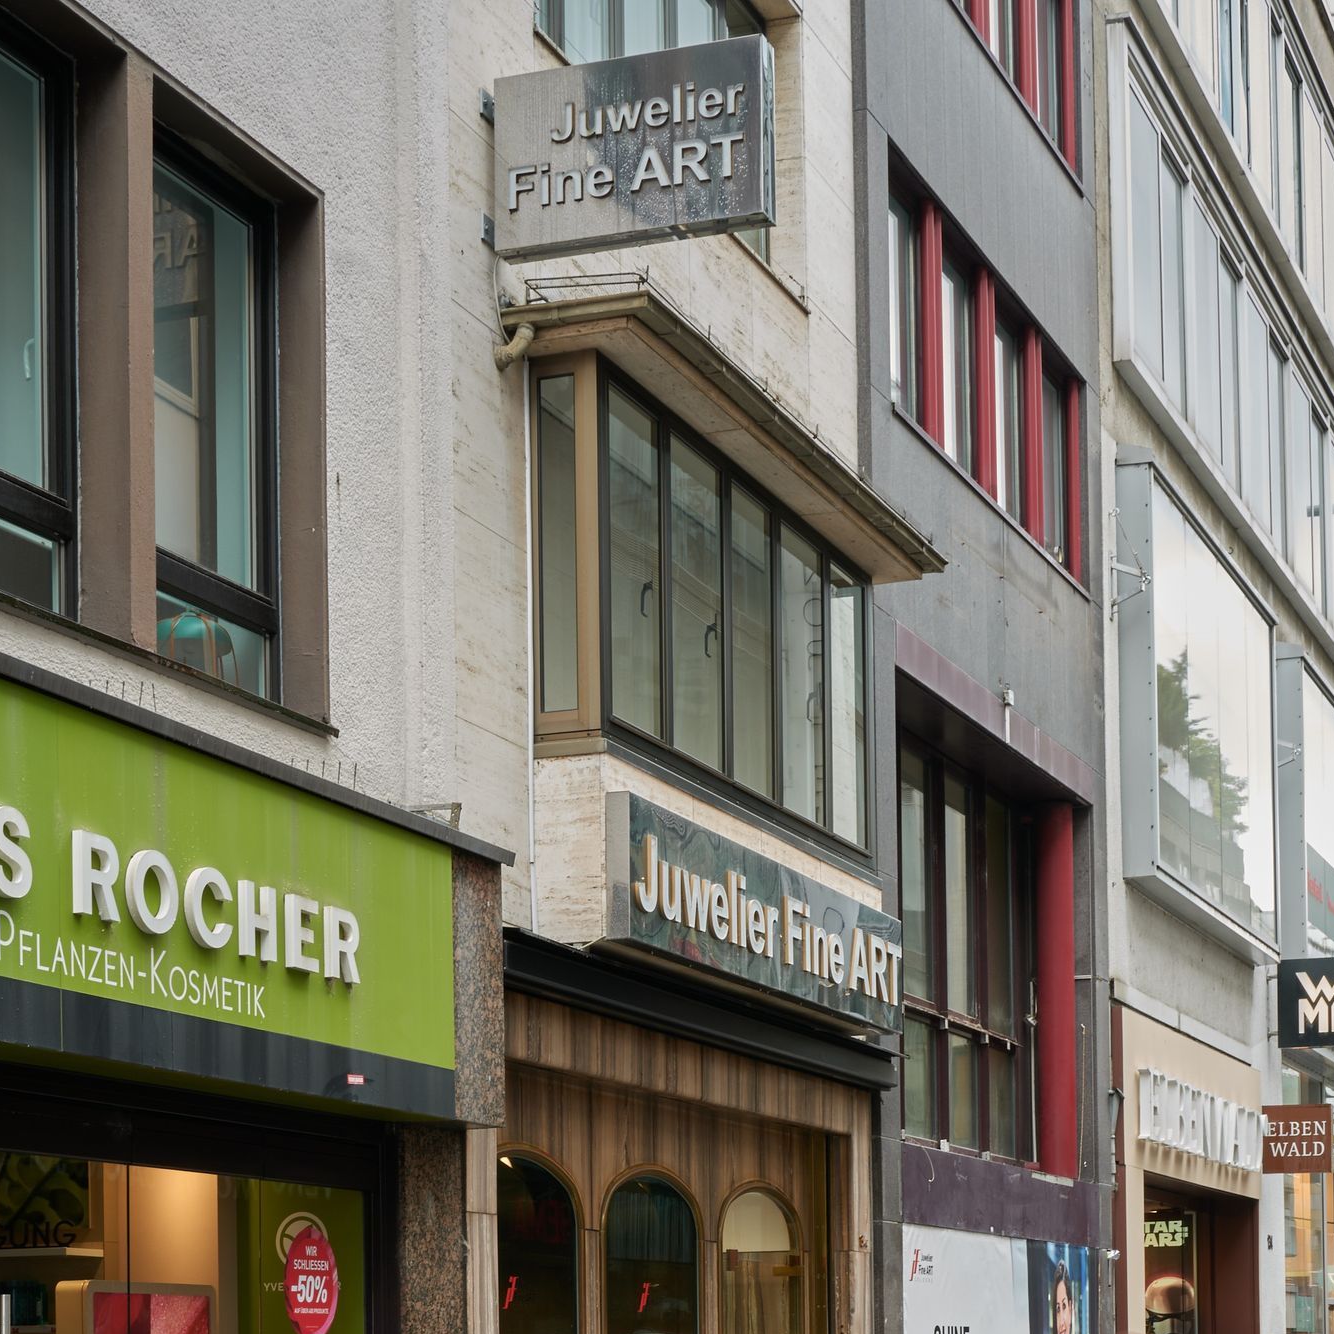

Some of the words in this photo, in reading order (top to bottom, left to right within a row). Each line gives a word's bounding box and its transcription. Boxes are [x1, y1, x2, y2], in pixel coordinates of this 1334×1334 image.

[551, 81, 744, 143] Juwelier
[508, 163, 614, 213] Fine
[630, 131, 744, 192] ART
[72, 828, 361, 984] ROCHER
[634, 834, 779, 958] Juwelier
[783, 895, 845, 985] Fine
[848, 928, 903, 1007] ART
[1267, 1120, 1327, 1137] ELBEN
[1270, 1141, 1325, 1158] WALD
[305, 1245, 317, 1256] WIR
[1144, 1233, 1183, 1247] ARS
[294, 1259, 329, 1271] SCHLIESSEN
[291, 1275, 327, 1304] -50%
